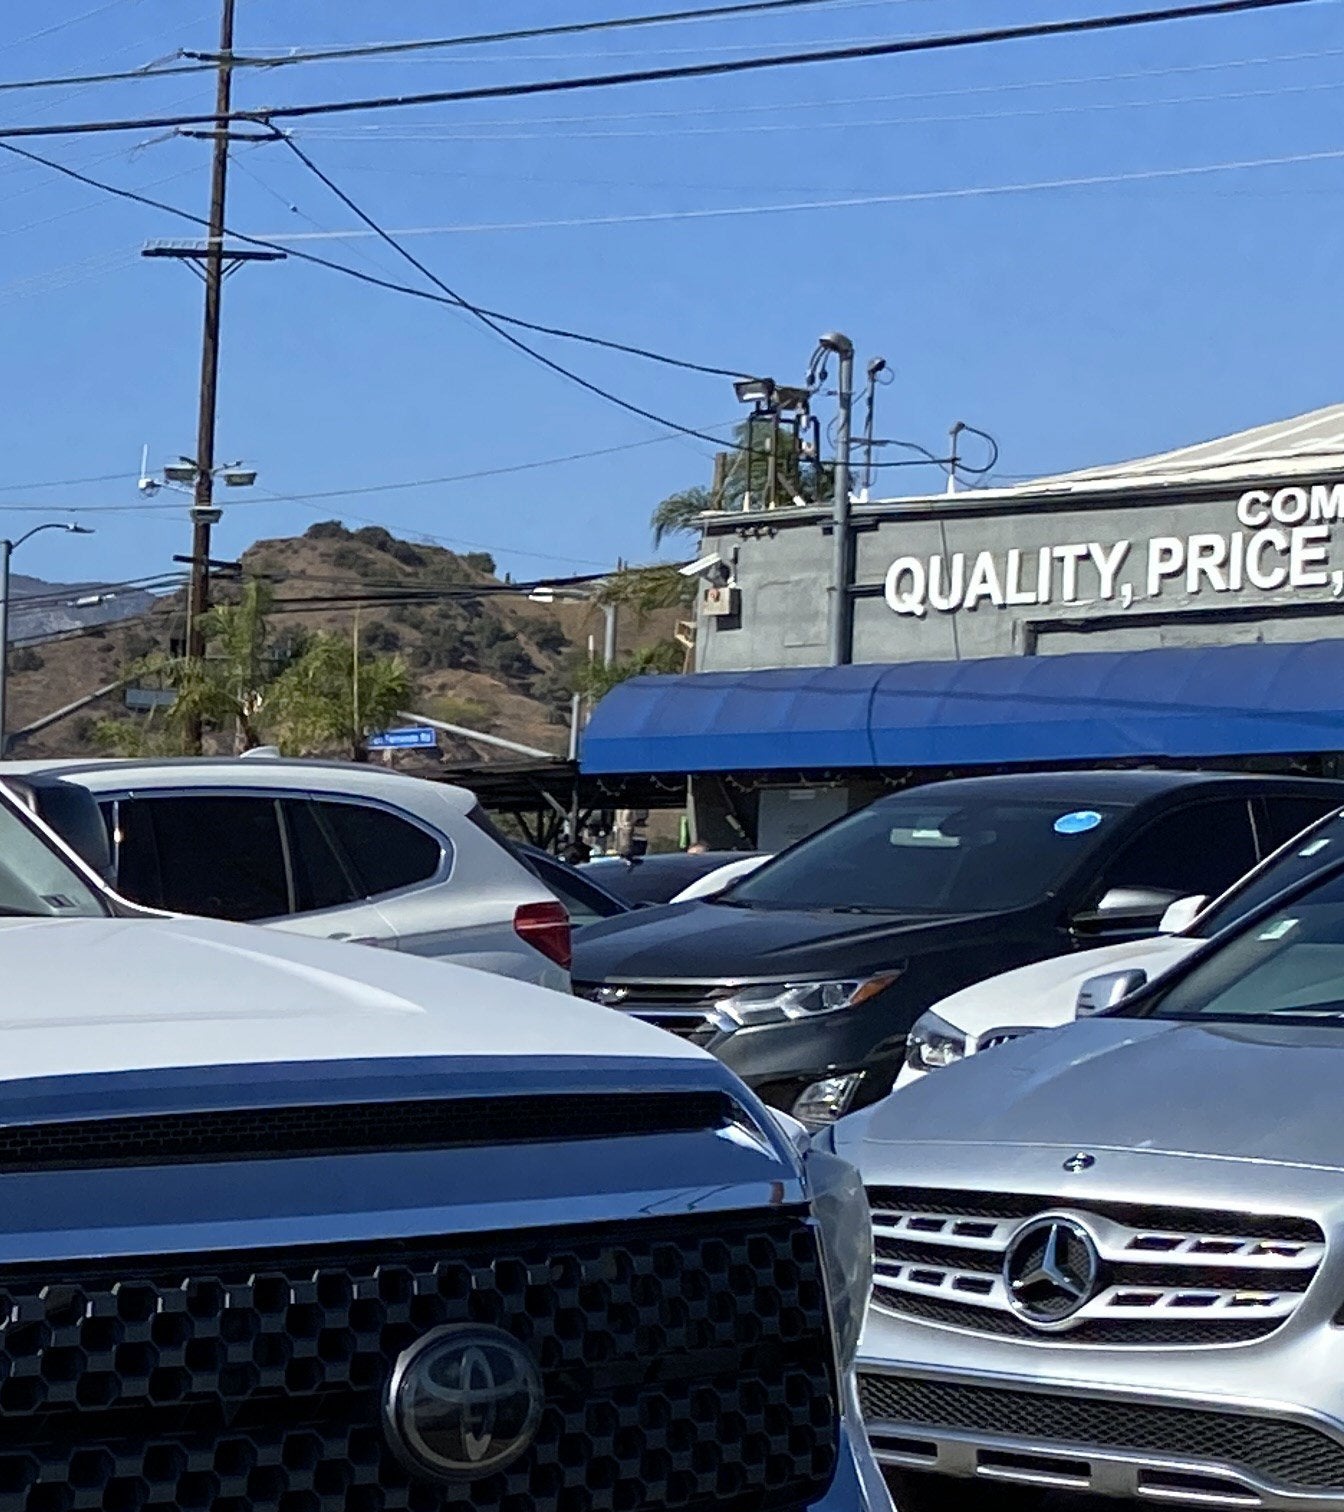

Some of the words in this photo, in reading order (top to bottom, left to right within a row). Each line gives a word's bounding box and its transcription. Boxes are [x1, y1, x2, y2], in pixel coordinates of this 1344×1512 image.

[1237, 483, 1344, 526] COM
[884, 540, 1133, 616] QUALITY,
[1146, 525, 1344, 597] PRICE,
